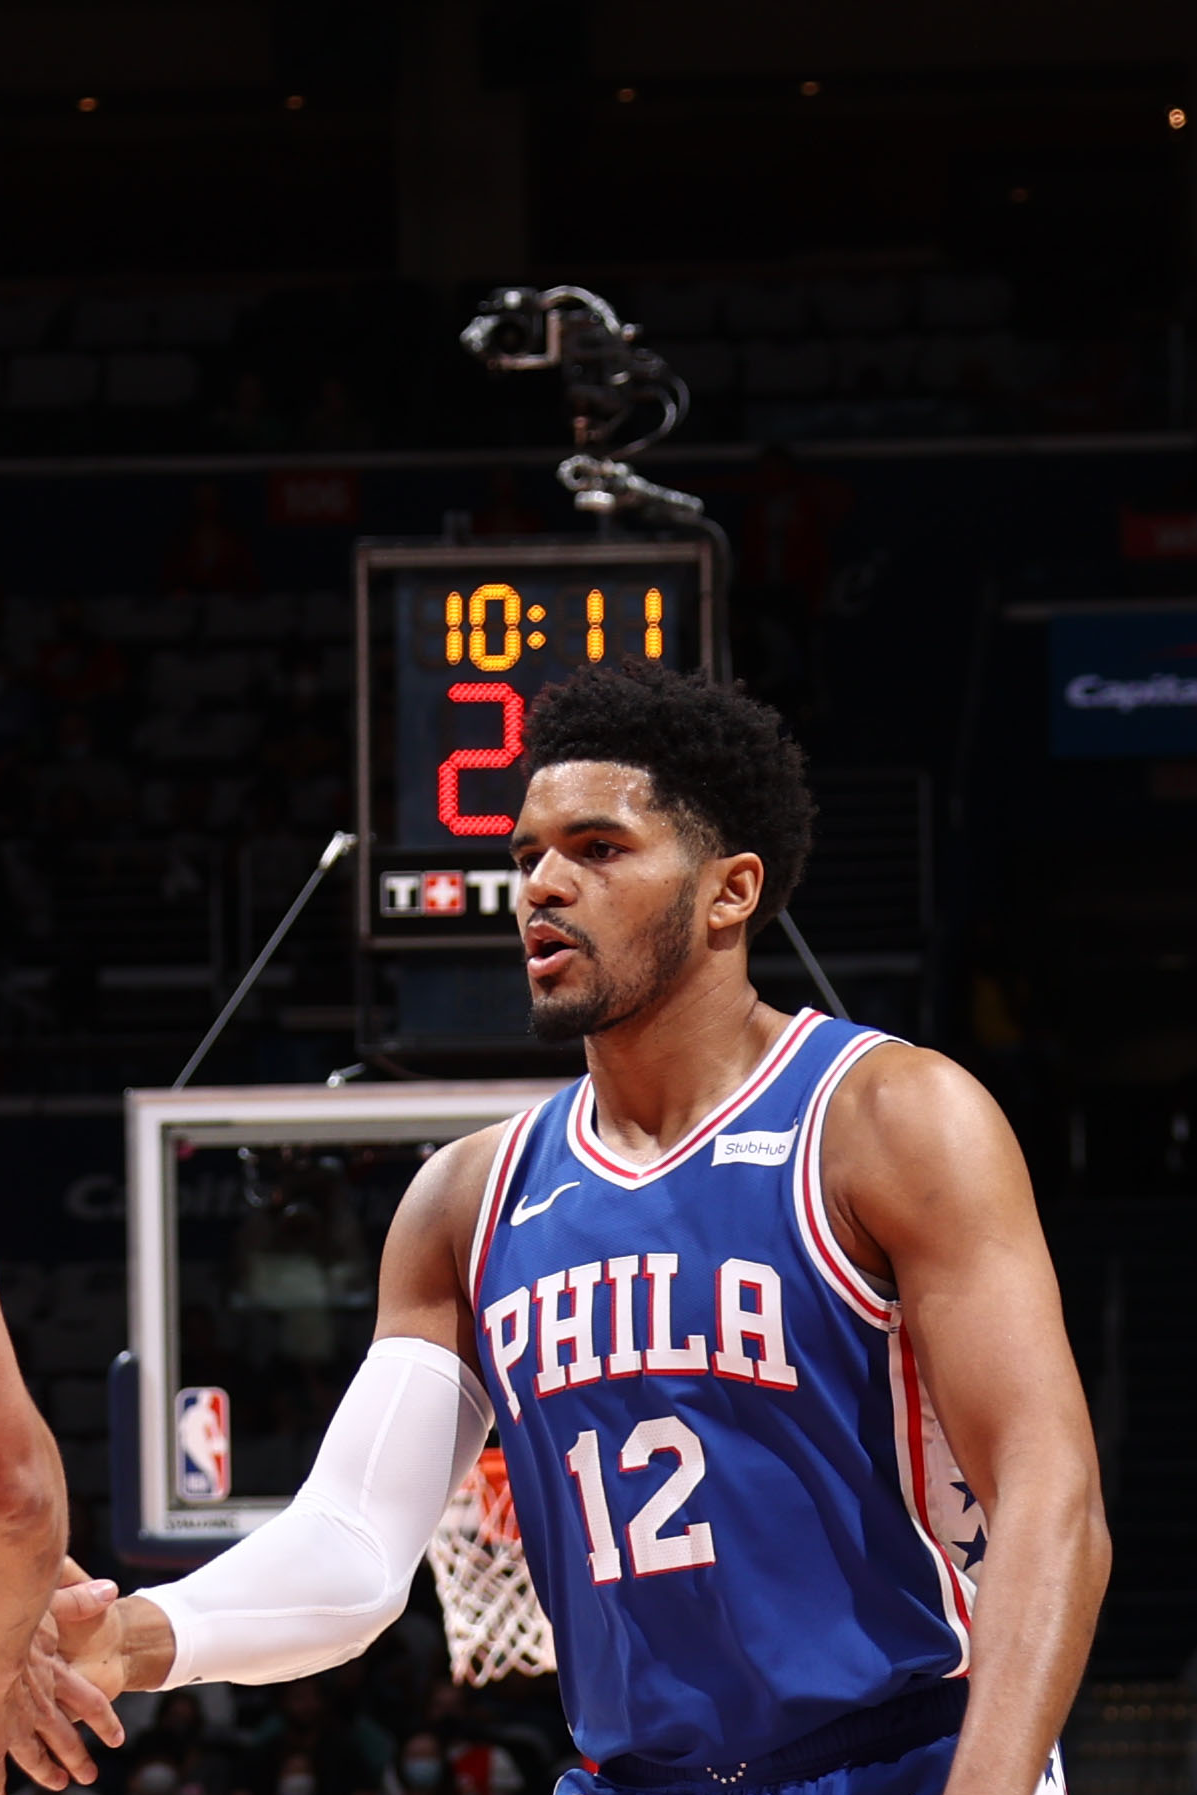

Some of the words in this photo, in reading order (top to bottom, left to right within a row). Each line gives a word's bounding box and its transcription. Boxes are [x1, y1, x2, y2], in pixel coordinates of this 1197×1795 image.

[445, 583, 663, 673] 10:11
[437, 682, 525, 836] 2
[724, 1140, 787, 1156] StubHub
[482, 1252, 799, 1424] PHILA
[565, 1416, 717, 1586] 12
